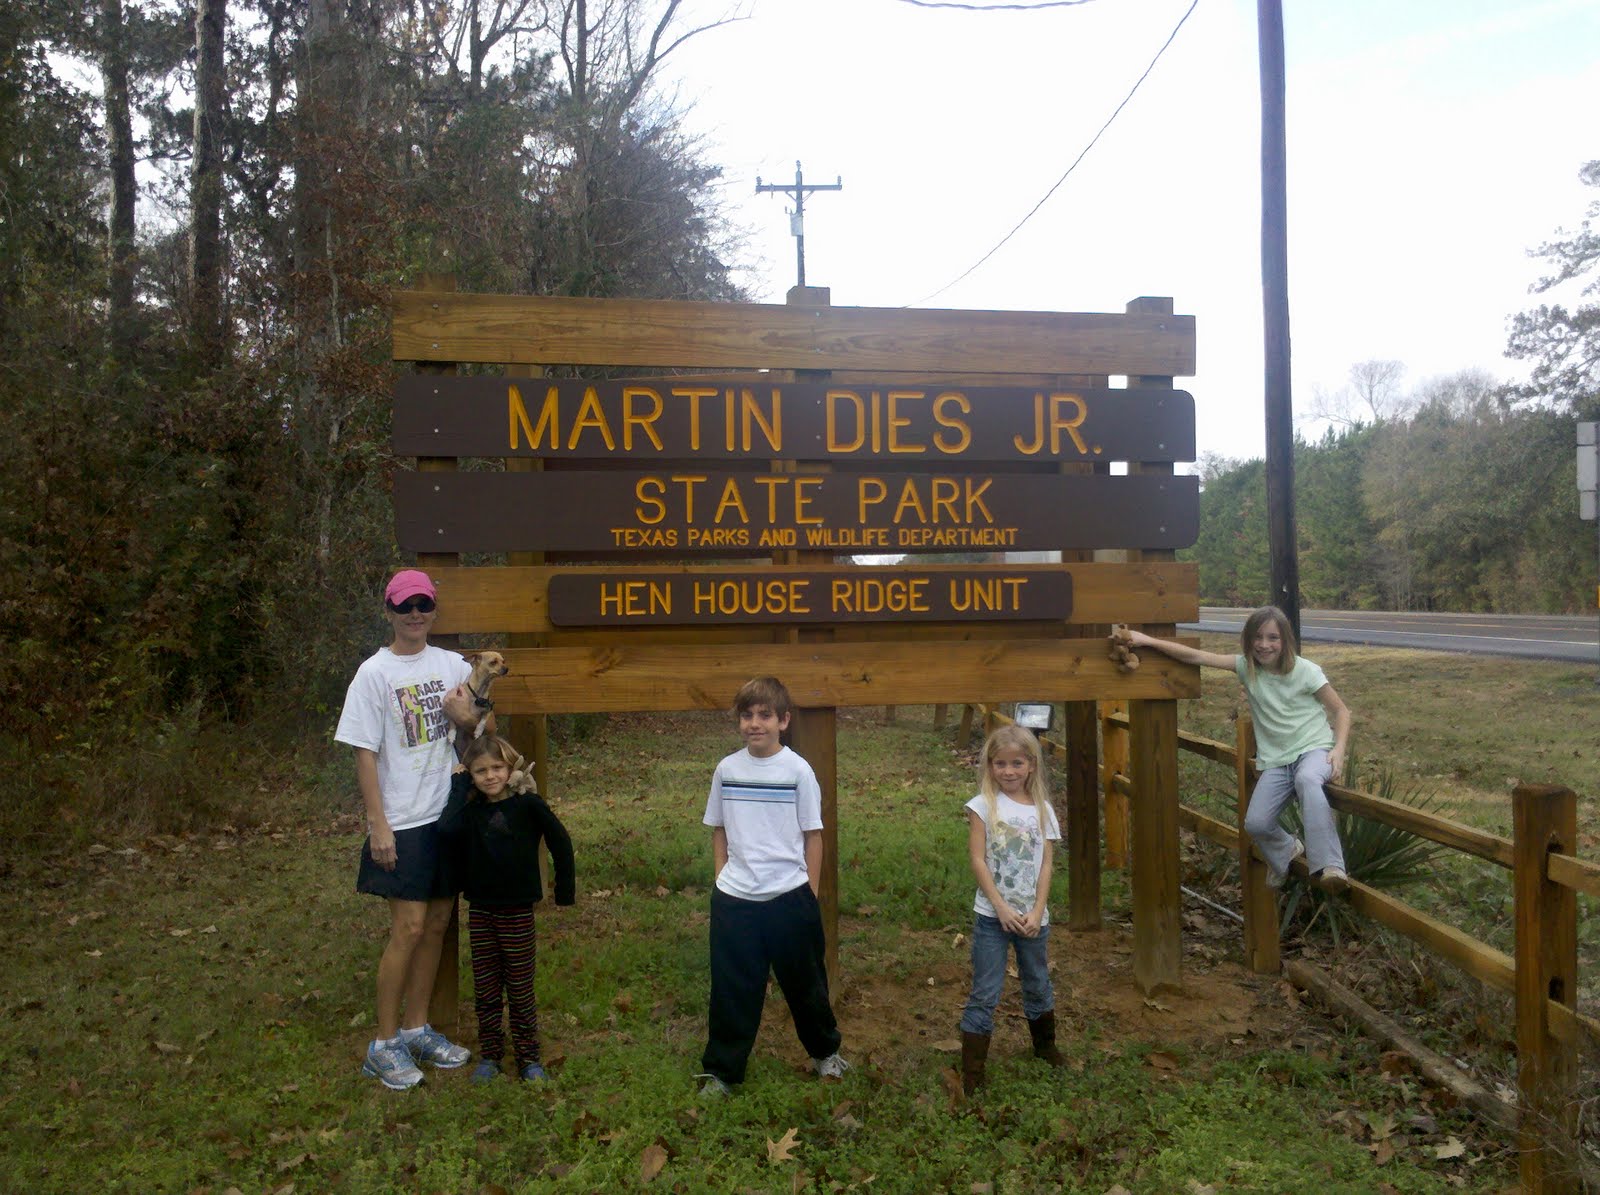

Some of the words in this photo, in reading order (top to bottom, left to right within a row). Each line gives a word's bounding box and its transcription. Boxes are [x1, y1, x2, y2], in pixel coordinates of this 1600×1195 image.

[507, 385, 782, 451] MARTIN
[825, 390, 972, 454] DIES
[1013, 393, 1103, 455] JR.
[635, 476, 824, 525] STATE
[859, 478, 994, 524] PARK
[610, 528, 679, 547] TEXAS
[687, 528, 750, 547] PARKS
[758, 528, 798, 547] AND
[805, 528, 890, 547] WILDLIFE
[898, 528, 1019, 547] DEPARTMENT
[600, 582, 672, 616] HEN
[694, 580, 811, 615] HOUSE
[831, 579, 931, 613] RIDGE
[949, 578, 1028, 611] UNIT
[414, 680, 446, 697] RACE
[419, 695, 442, 712] FOR
